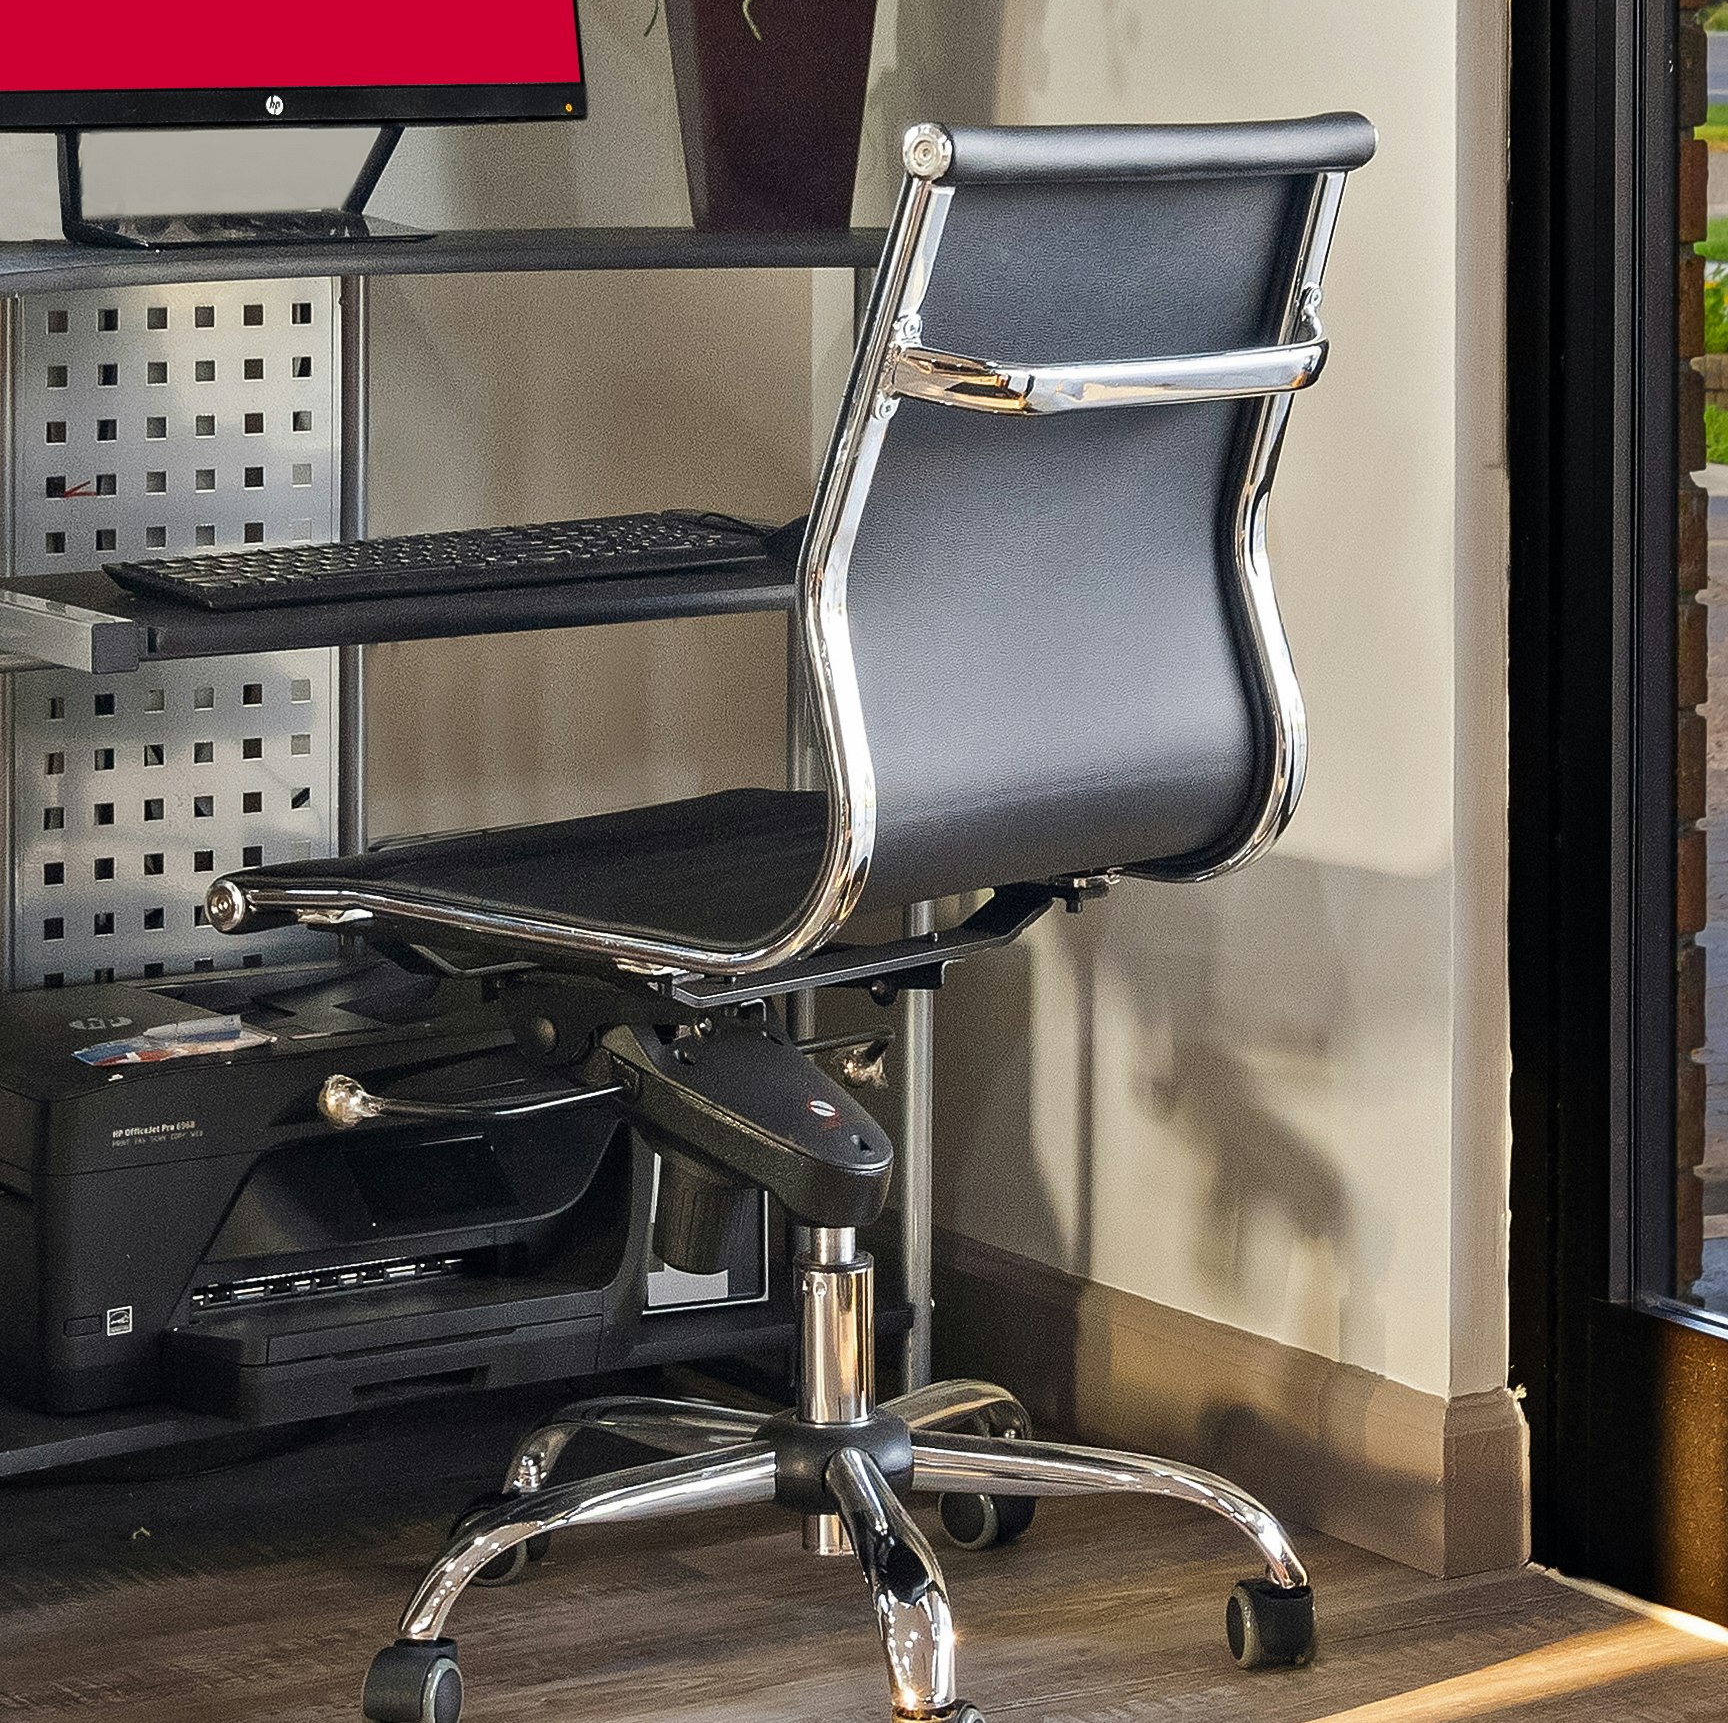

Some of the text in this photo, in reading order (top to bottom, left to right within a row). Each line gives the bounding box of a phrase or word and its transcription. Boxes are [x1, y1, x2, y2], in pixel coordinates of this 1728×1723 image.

[112, 1129, 123, 1139] HP
[124, 1125, 160, 1137] OfficeJet
[161, 1123, 175, 1132] Pro
